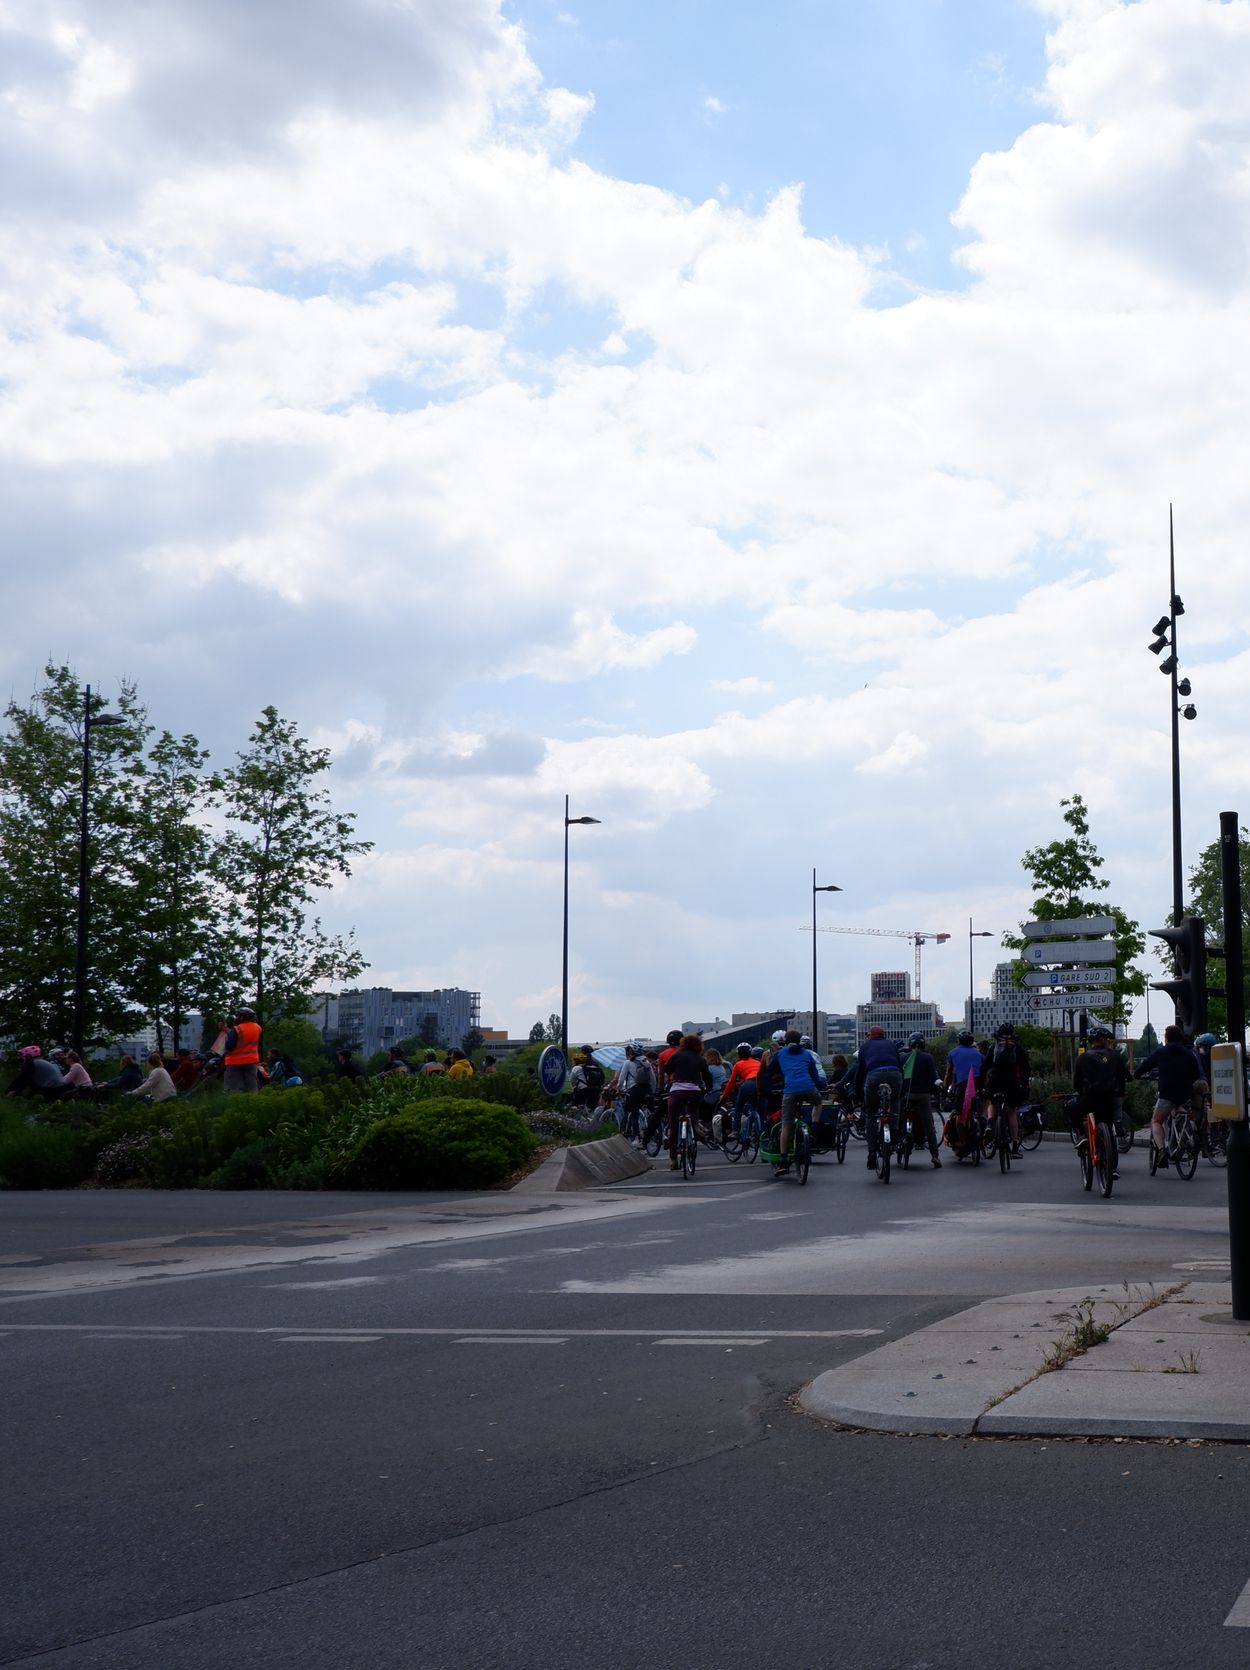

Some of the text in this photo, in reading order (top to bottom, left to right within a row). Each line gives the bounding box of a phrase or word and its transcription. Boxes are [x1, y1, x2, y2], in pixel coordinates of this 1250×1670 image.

[1061, 974, 1080, 982] GARE
[1084, 972, 1100, 980] SUD
[1104, 972, 1110, 980] 2
[1065, 995, 1086, 1004] HÔTEL
[1090, 995, 1107, 1004] DIEU
